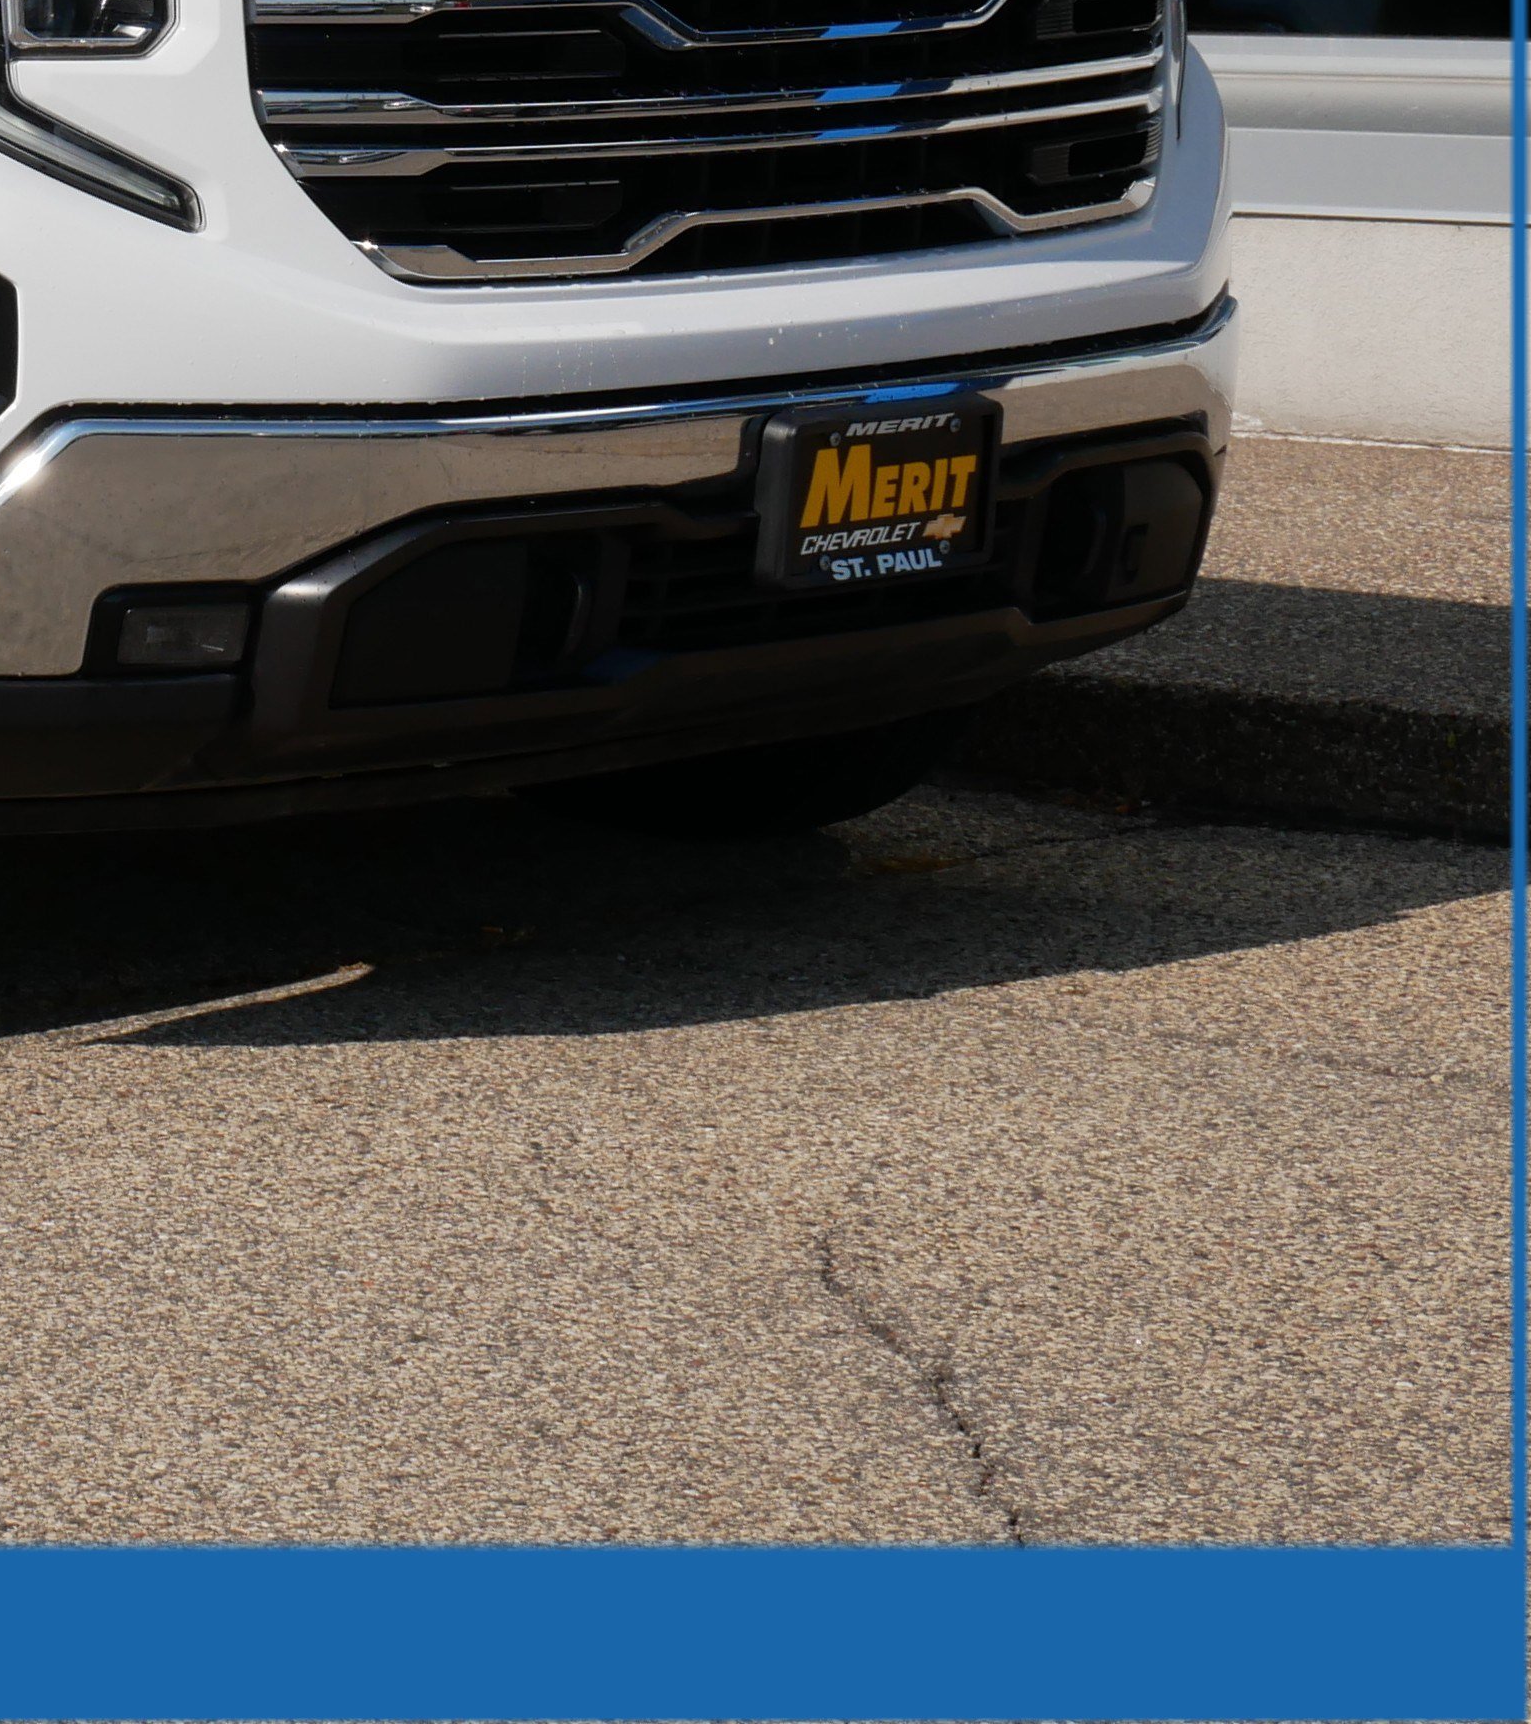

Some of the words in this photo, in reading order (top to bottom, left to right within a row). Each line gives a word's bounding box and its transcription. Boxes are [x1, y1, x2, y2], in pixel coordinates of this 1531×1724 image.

[847, 413, 953, 437] MERIT
[800, 522, 920, 556] CHEVROLET
[831, 558, 872, 581] ST.
[878, 550, 943, 574] PAUL
